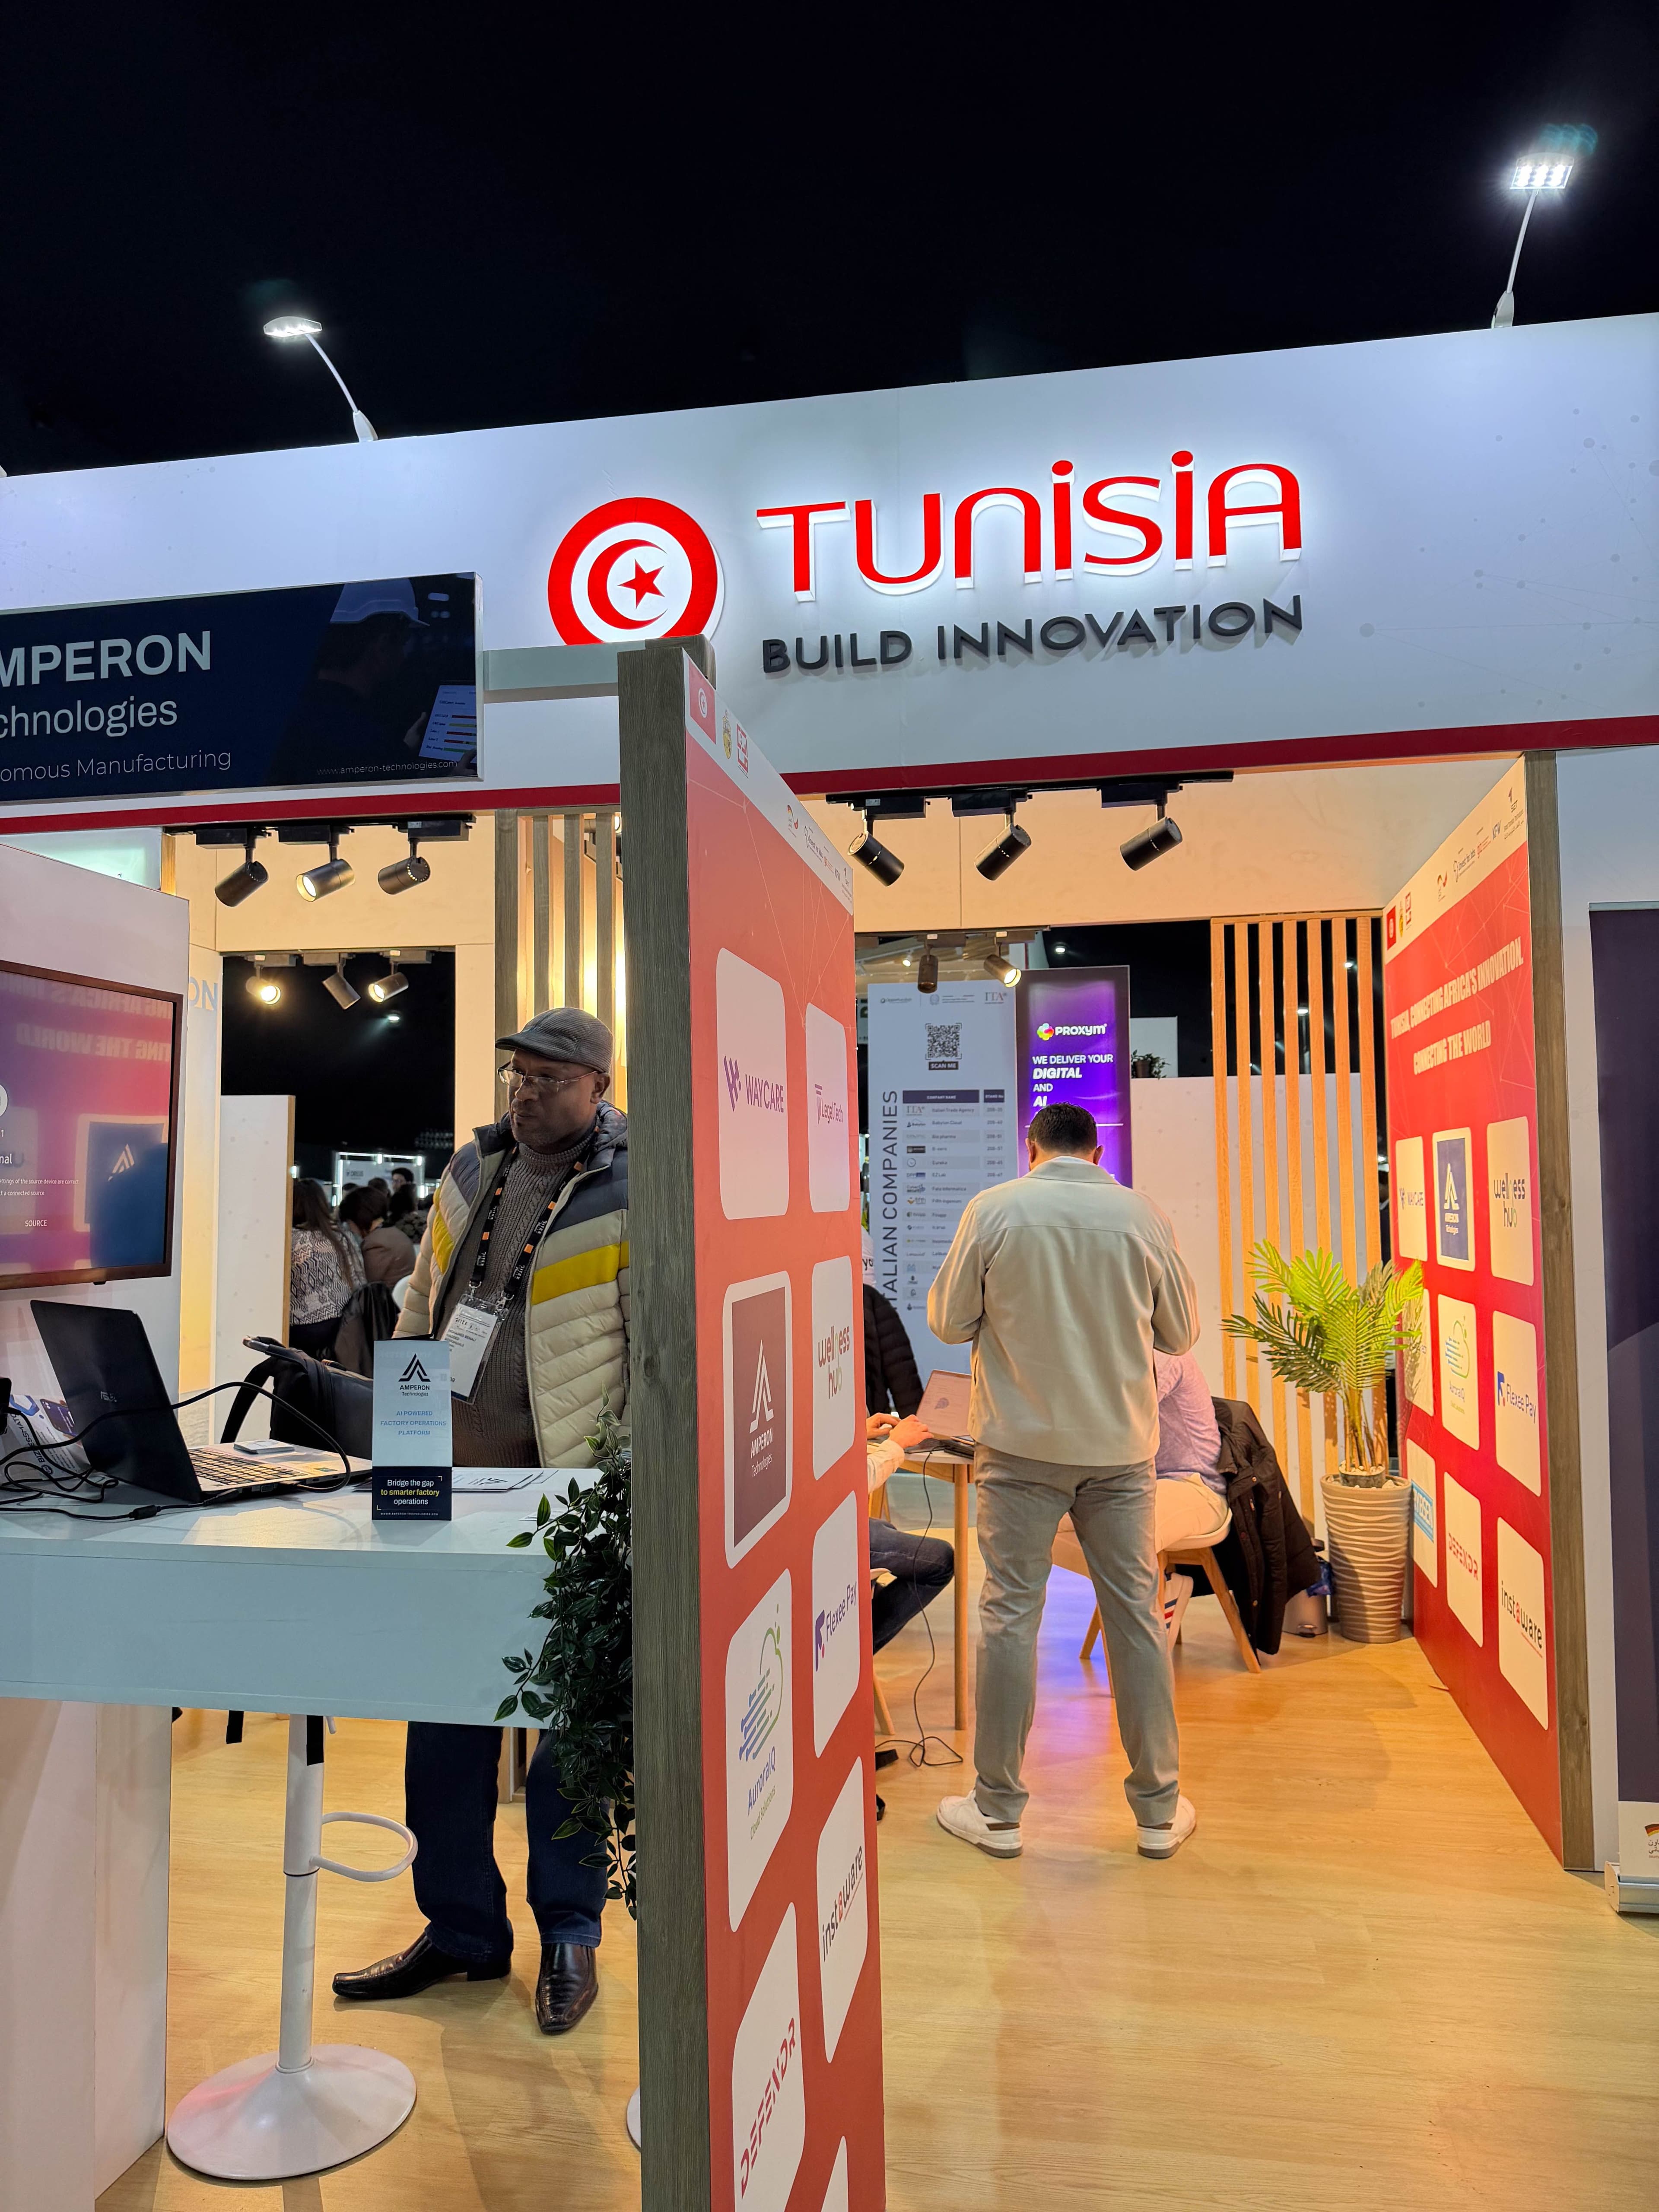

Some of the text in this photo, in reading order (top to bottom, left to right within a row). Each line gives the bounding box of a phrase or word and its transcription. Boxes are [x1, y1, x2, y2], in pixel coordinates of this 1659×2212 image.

[763, 595, 1303, 674] BUILD INNOVATION
[0, 631, 210, 687] MPERON
[0, 750, 231, 782] omous Manufacturing
[318, 761, 458, 775] www.amperon-technologies.com
[1410, 986, 1443, 1028] CONNECTING
[1443, 967, 1477, 1009] AFRICA'S
[1477, 936, 1524, 992] INNOVATION.
[1032, 1054, 1113, 1065] WE DELIVER YOUR
[1413, 1020, 1491, 1075] CONNECTING THE WORLD
[1033, 1067, 1082, 1079] DIGITAL
[1033, 1084, 1053, 1092] AND
[745, 1074, 784, 1113] WAYCARE
[821, 1097, 843, 1124] LegalTech
[1033, 1096, 1048, 1106] AI
[883, 1090, 897, 1220] COMPANIES
[1494, 1173, 1525, 1200] wellness
[1503, 1201, 1517, 1227] hub
[883, 1227, 897, 1310] TALIAN
[818, 1325, 850, 1368] wellness
[828, 1364, 842, 1399] hub
[1506, 1383, 1536, 1424] Flexee Pay
[751, 1427, 773, 1459] AMPERON
[752, 1453, 772, 1478] Technologies
[416, 1489, 440, 1497] factory
[1449, 1532, 1478, 1580] DEFENDR
[826, 1581, 857, 1642] Flexee Pay
[1501, 1580, 1542, 1649] instaware
[750, 1785, 776, 1840] Cloud Solutions
[822, 1845, 863, 1962] instaware
[741, 2017, 796, 2199] DEFENDR
